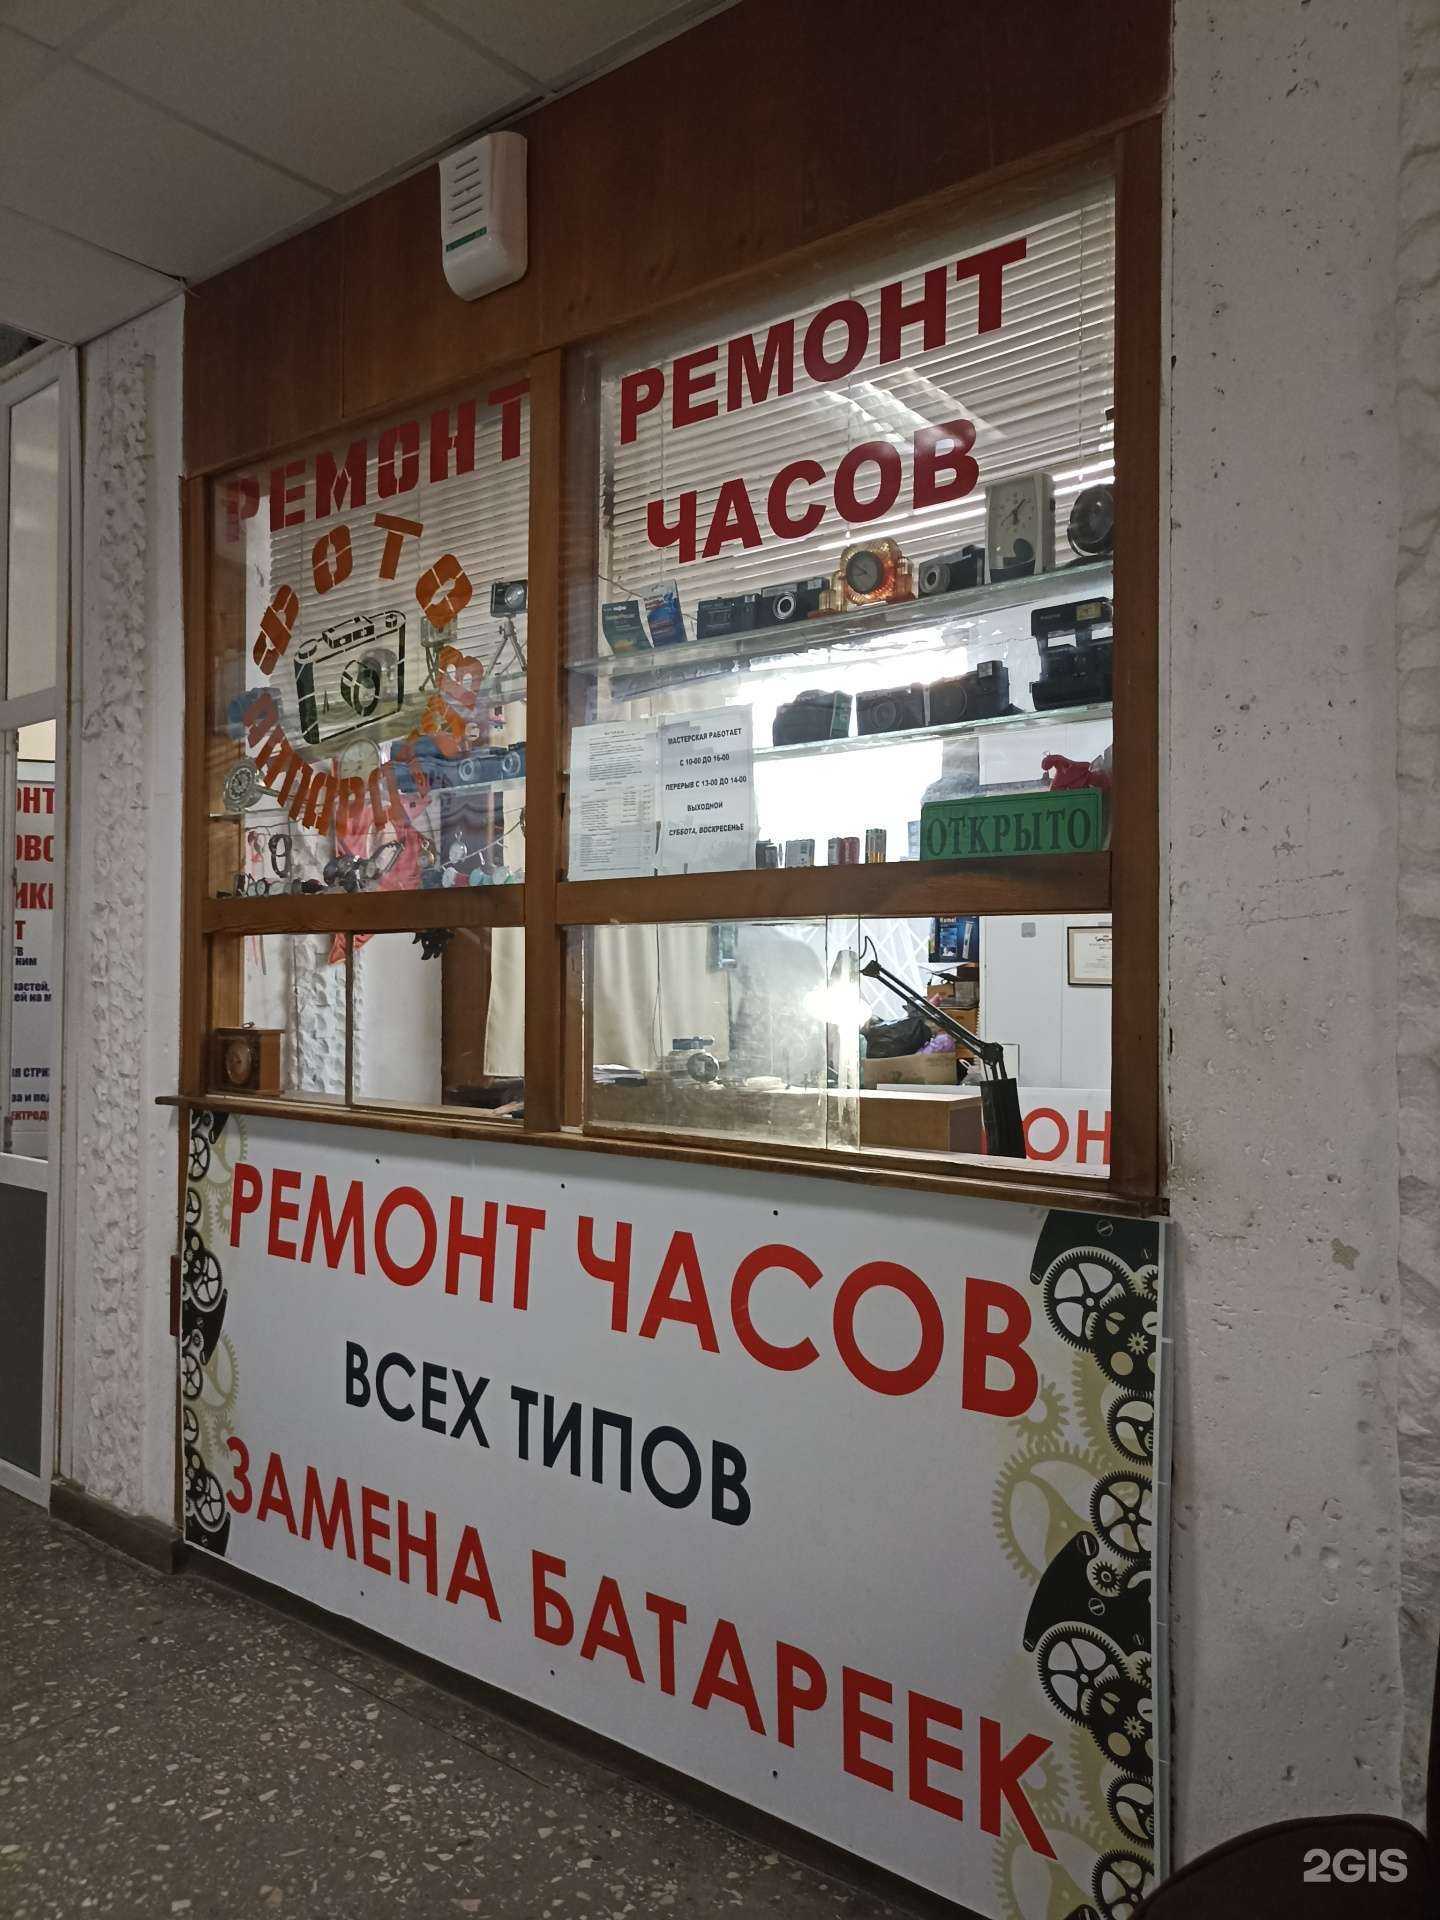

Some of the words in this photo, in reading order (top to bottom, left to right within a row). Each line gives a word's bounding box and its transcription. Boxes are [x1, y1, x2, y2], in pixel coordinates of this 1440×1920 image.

[620, 237, 1027, 445] РЕМОНТ
[224, 378, 530, 543] РЕМОНТ
[646, 418, 980, 564] ЧАСОВ
[667, 732, 707, 745] МАСТЕРСКАЯ
[708, 727, 742, 739] РАБОТАЕТ
[679, 758, 684, 766] С
[685, 756, 701, 766] 10-00
[702, 755, 712, 765] ДО
[665, 780, 695, 791] ПЕРЕРЫВ
[695, 779, 700, 788] С
[701, 777, 718, 787] 13-00
[719, 776, 729, 786] ДО
[730, 775, 747, 784] 14-00
[687, 801, 723, 812] ВЫХОДНОЙ
[698, 823, 744, 834] ВОСКРЕСЕНЬЕ
[927, 808, 1091, 856] ОТКРЫТО
[979, 1107, 1111, 1165] ОН
[229, 1162, 546, 1311] РЕМОНТ
[576, 1215, 1040, 1418] ЧАСОВ
[345, 1340, 490, 1449] ВСЕХ
[509, 1385, 752, 1527] ТИПОВ
[225, 1436, 502, 1624] ЗАМЕНА
[531, 1548, 1058, 1861] БАТАРЕЕК
